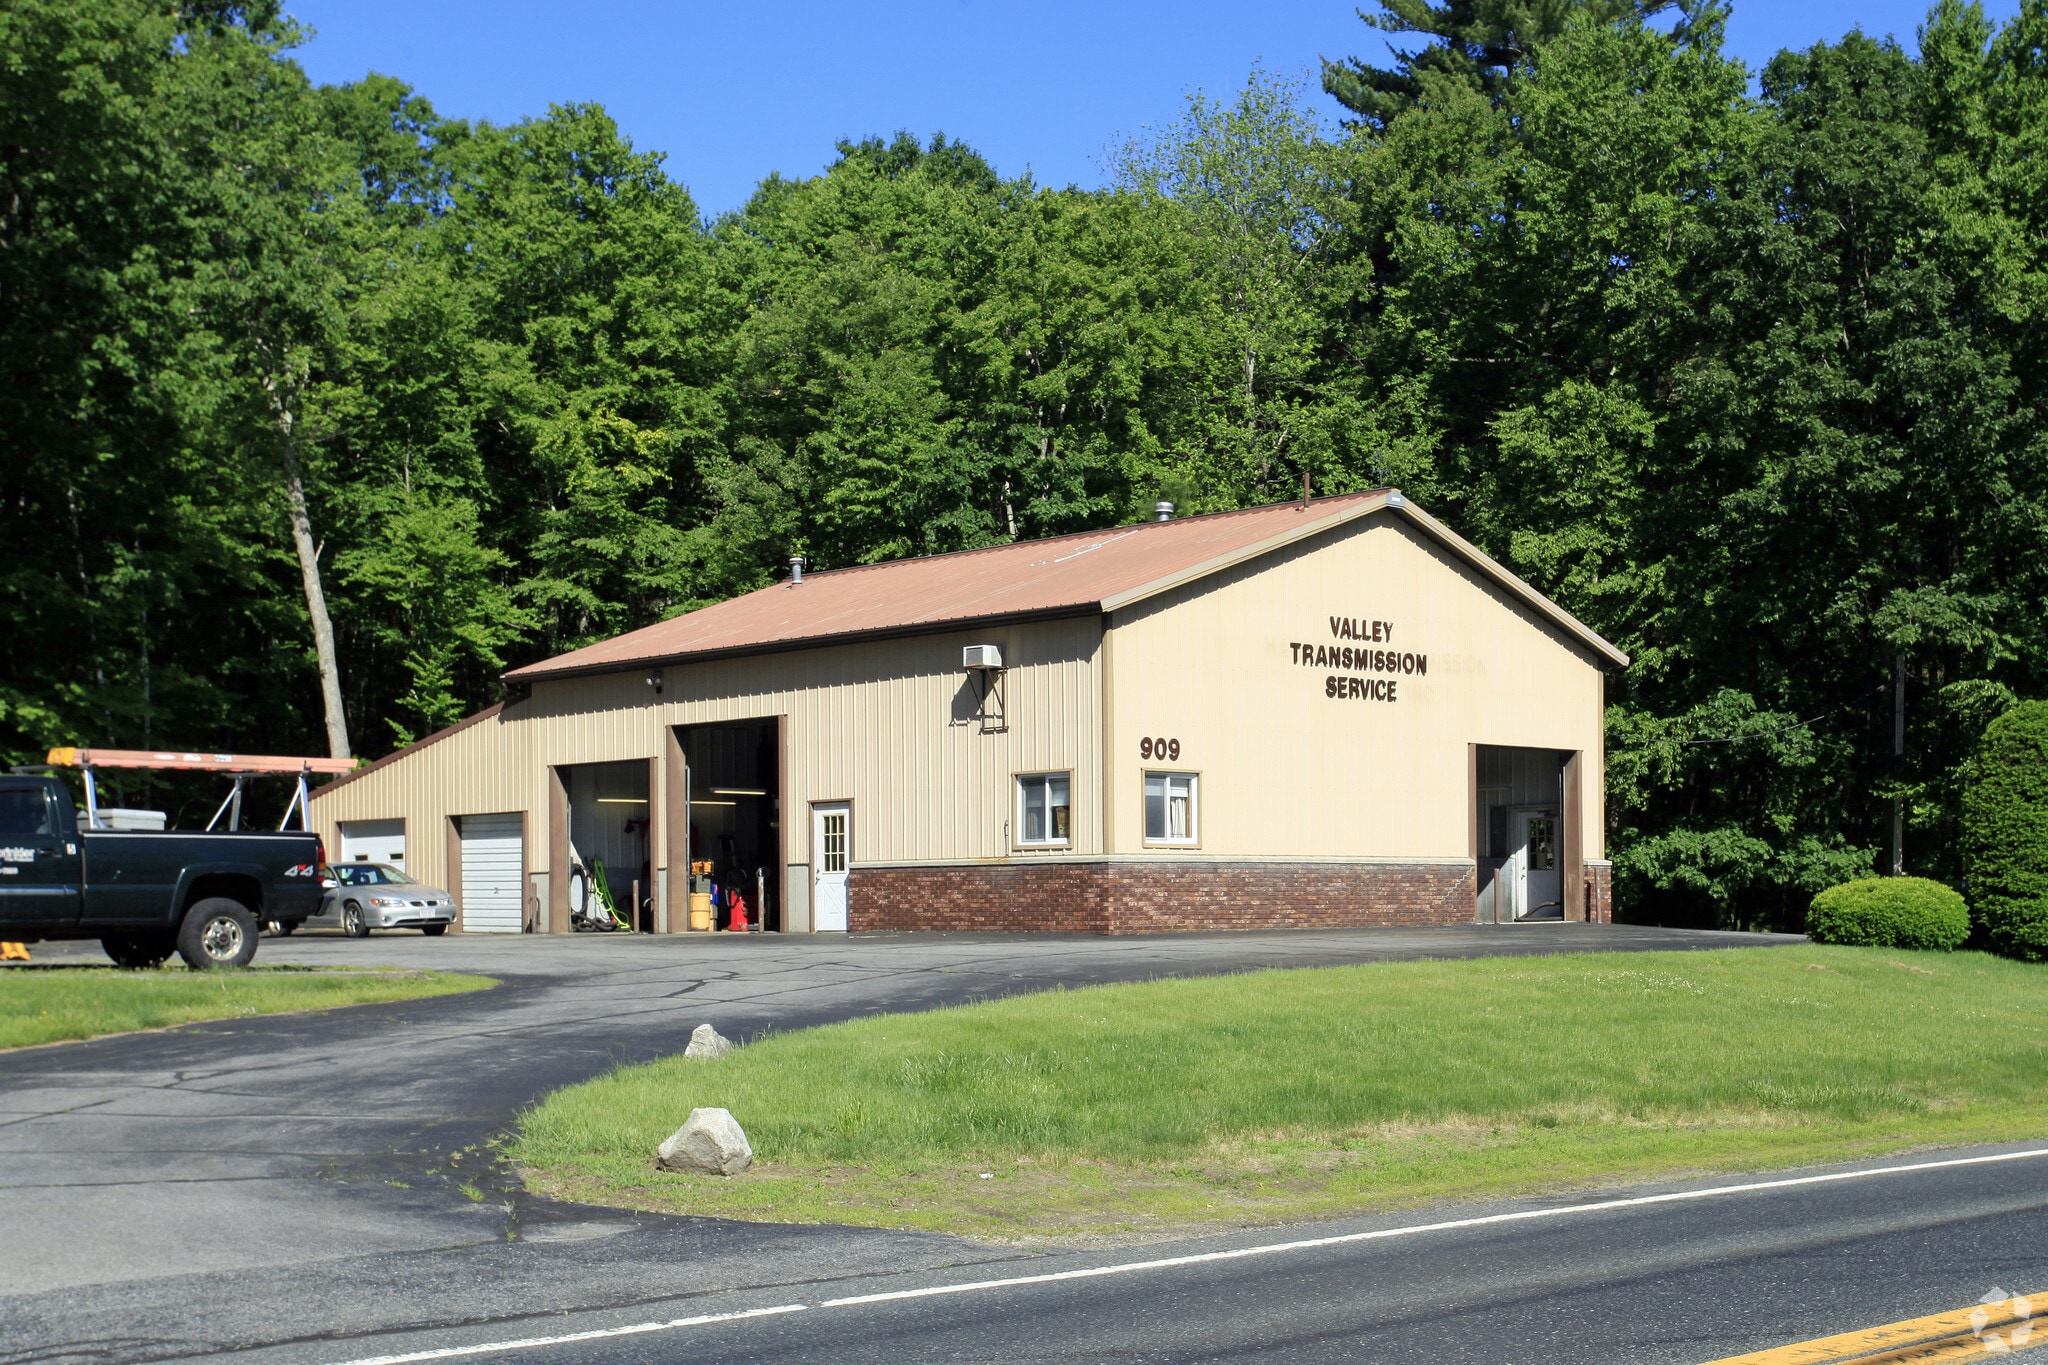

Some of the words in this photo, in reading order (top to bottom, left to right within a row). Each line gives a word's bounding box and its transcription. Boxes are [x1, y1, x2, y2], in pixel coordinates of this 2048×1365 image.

[1329, 616, 1393, 643] VALLEY
[1289, 642, 1427, 676] TRANSMISSION
[1325, 676, 1397, 702] SERVICE
[1140, 737, 1181, 761] 909
